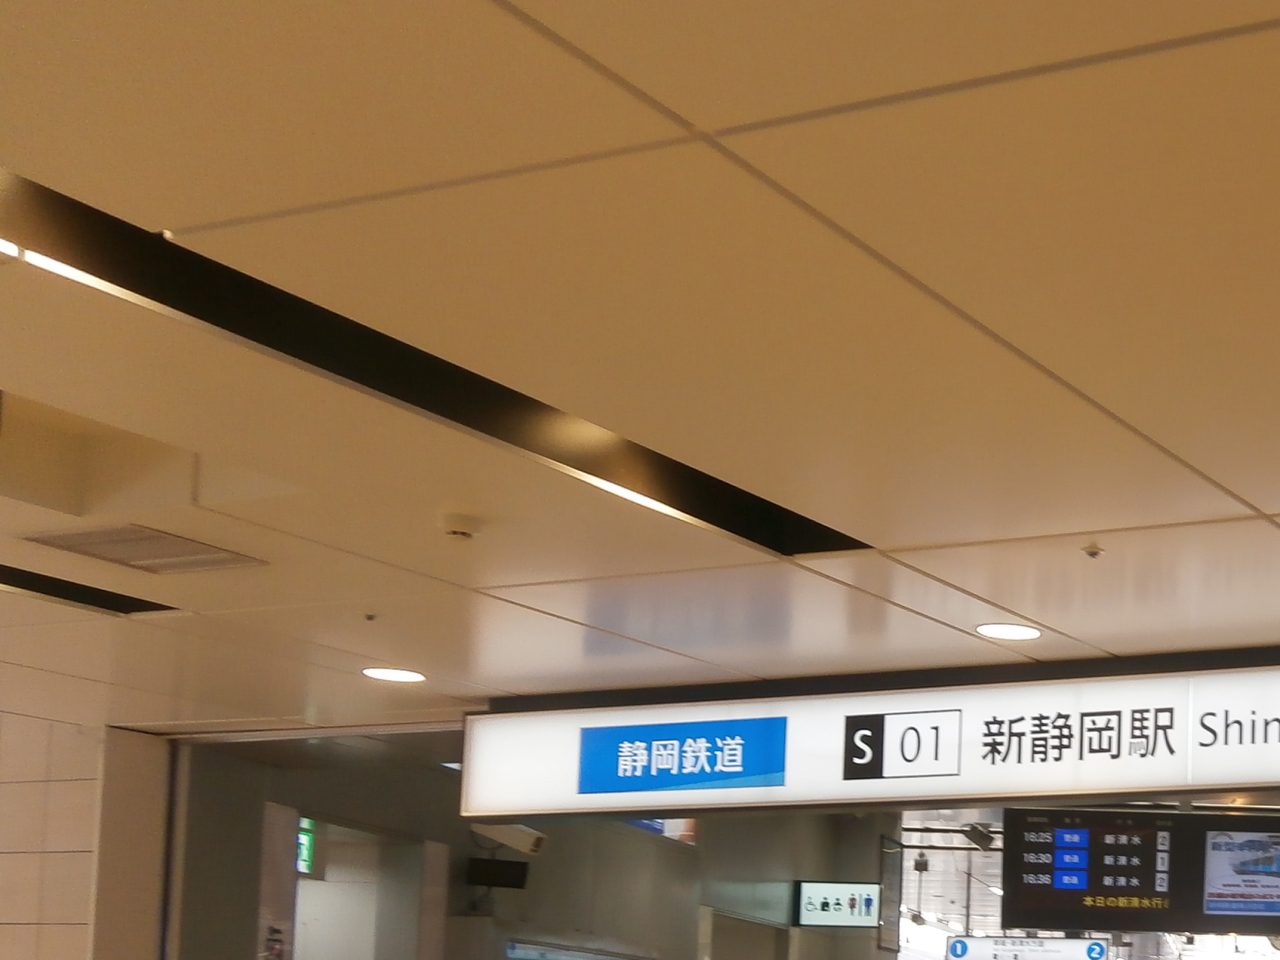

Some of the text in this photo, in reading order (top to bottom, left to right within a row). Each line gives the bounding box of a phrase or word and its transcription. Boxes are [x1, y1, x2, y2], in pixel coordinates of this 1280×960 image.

[617, 735, 745, 778] 静岡鉄道
[853, 725, 943, 765] S 01
[980, 708, 1176, 766] 新静岡駅
